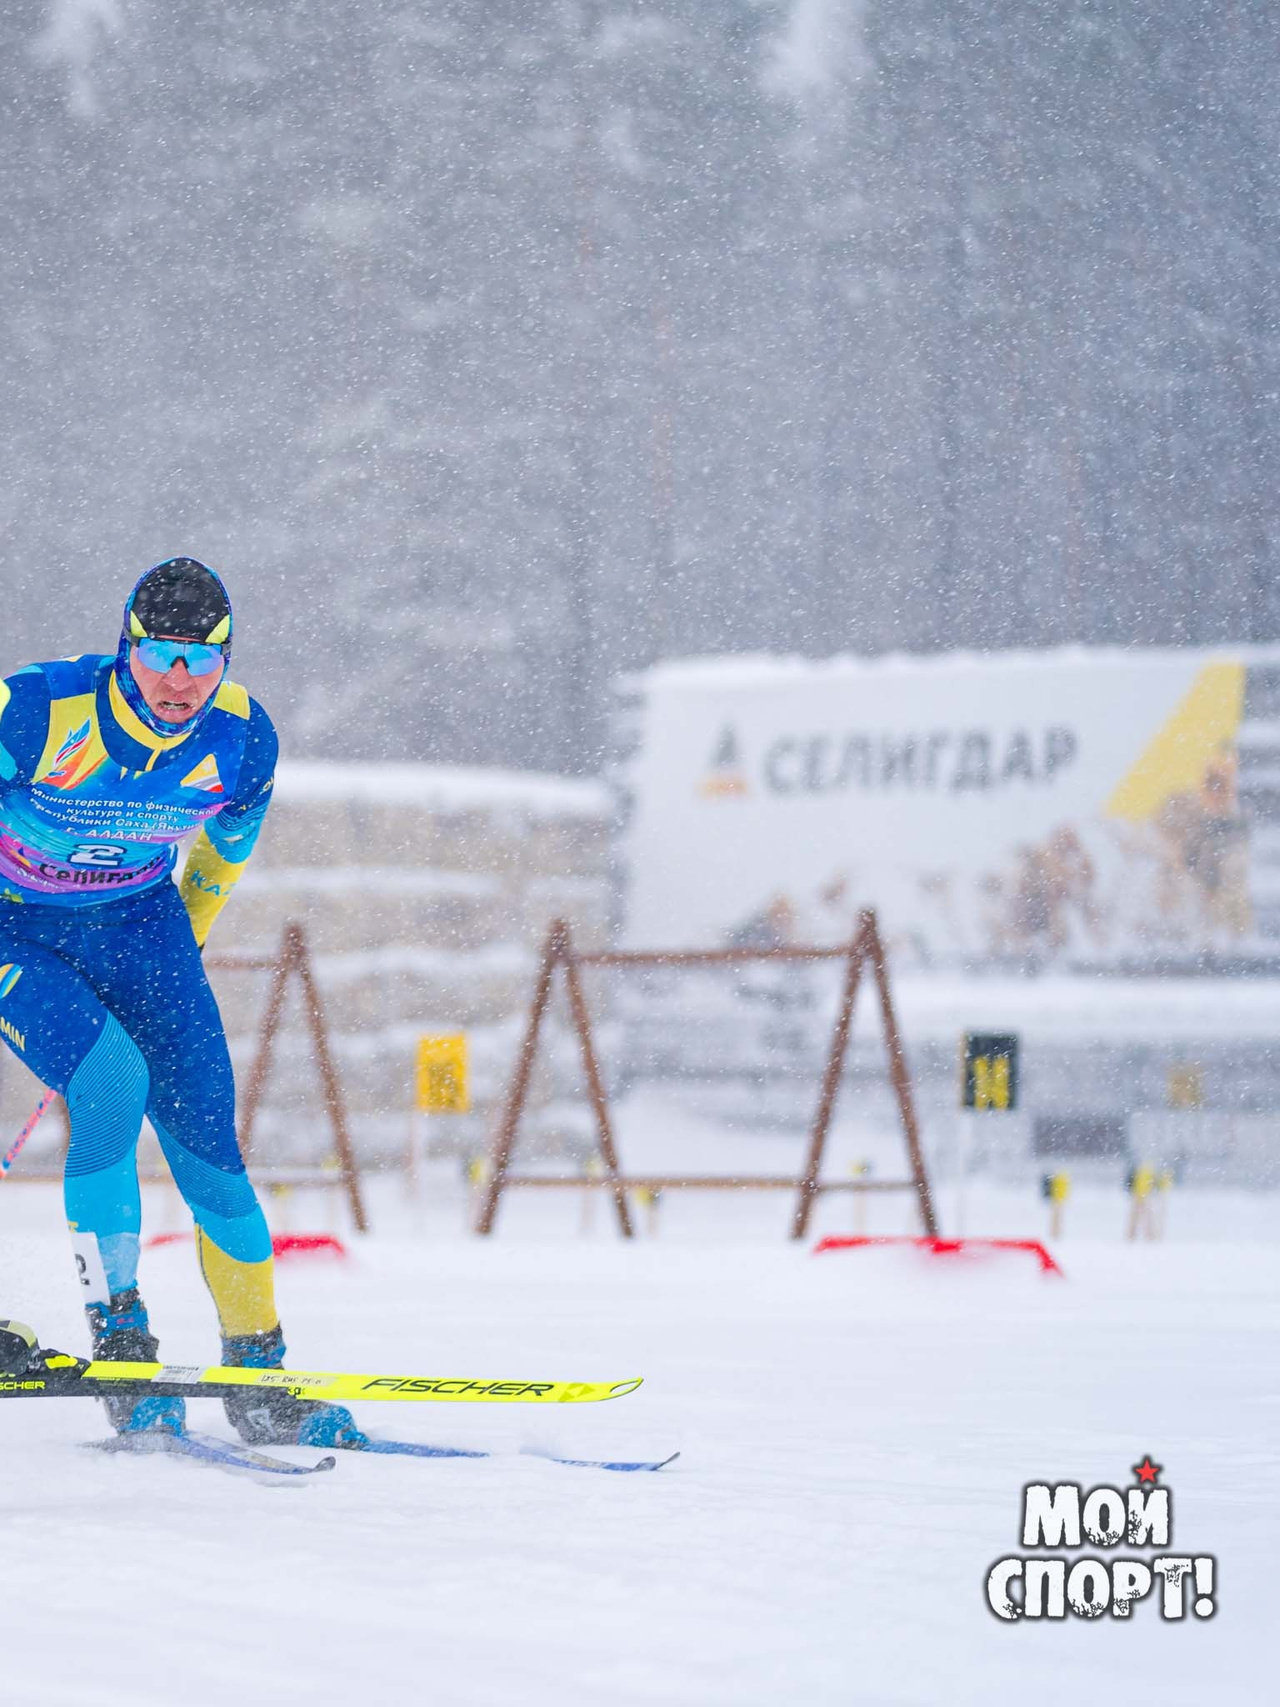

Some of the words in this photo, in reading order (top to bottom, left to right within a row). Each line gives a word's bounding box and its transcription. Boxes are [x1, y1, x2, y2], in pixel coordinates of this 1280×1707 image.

[31, 786, 124, 808] Министерство
[127, 800, 142, 809] по
[66, 808, 122, 818] культуре
[137, 811, 179, 823] спорту
[115, 818, 148, 830] Саха
[86, 829, 153, 842] АЛДАН
[68, 843, 127, 868] 2
[361, 1378, 555, 1397] FISCHER
